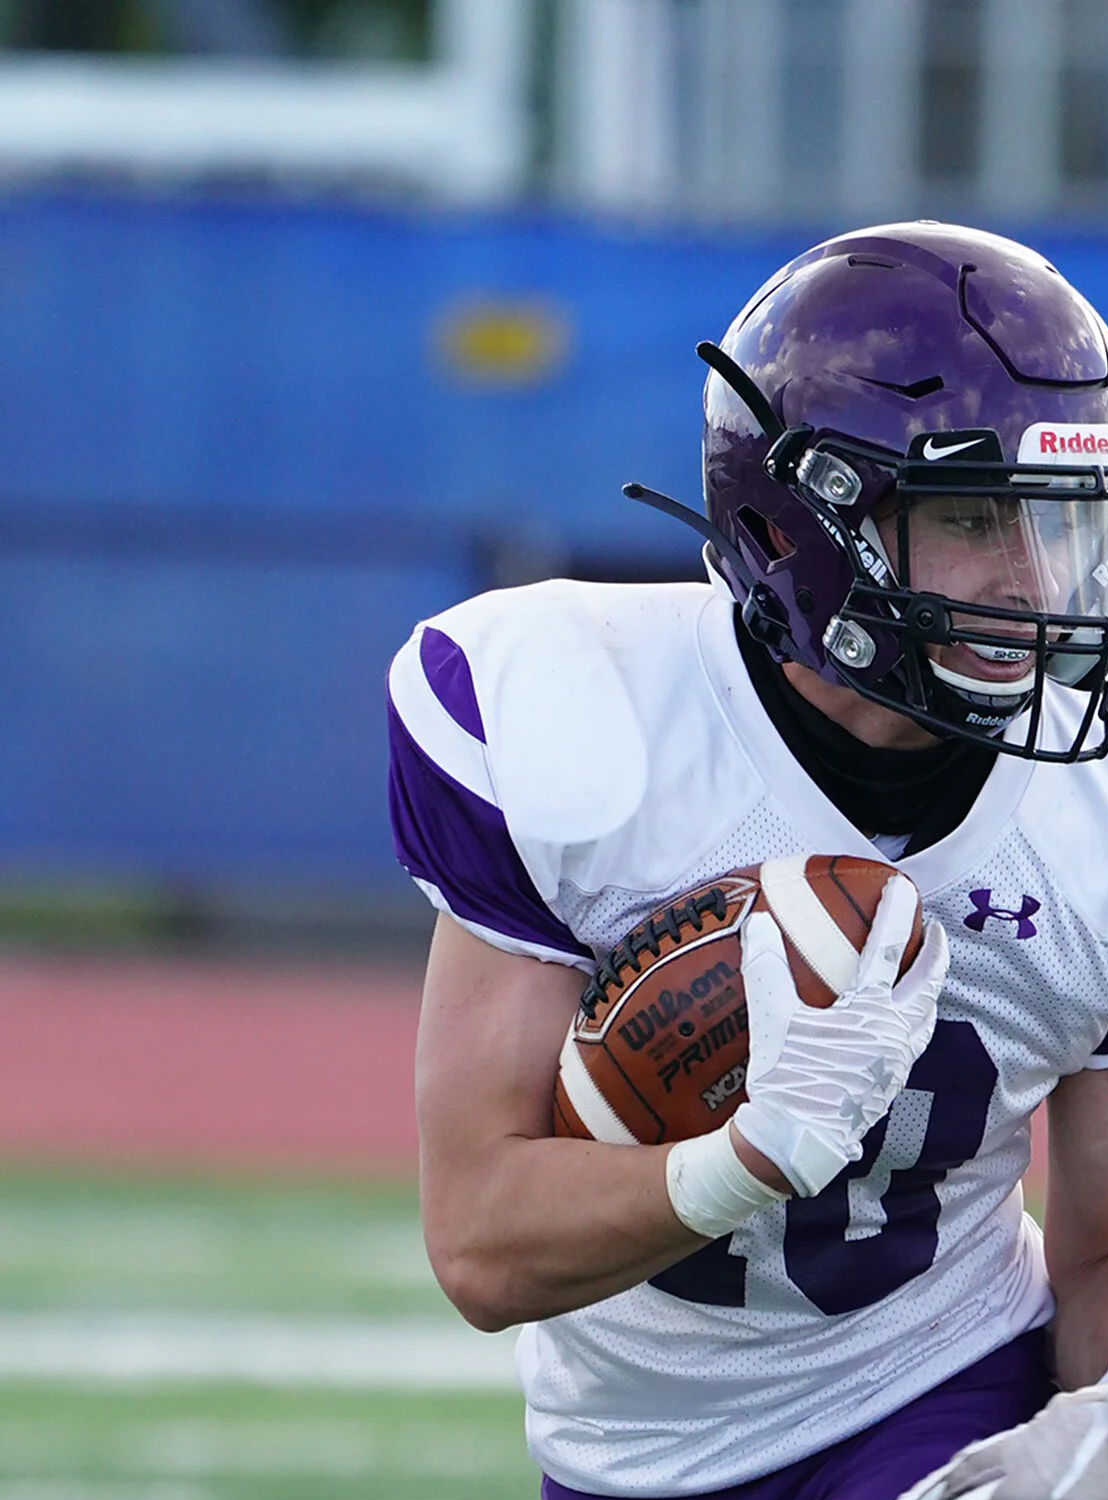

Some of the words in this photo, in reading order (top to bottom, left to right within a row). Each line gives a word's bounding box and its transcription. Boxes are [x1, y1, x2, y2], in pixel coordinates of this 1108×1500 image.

[617, 961, 737, 1052] Wilson
[701, 1057, 749, 1111] NCA
[648, 1018, 999, 1317] 0
